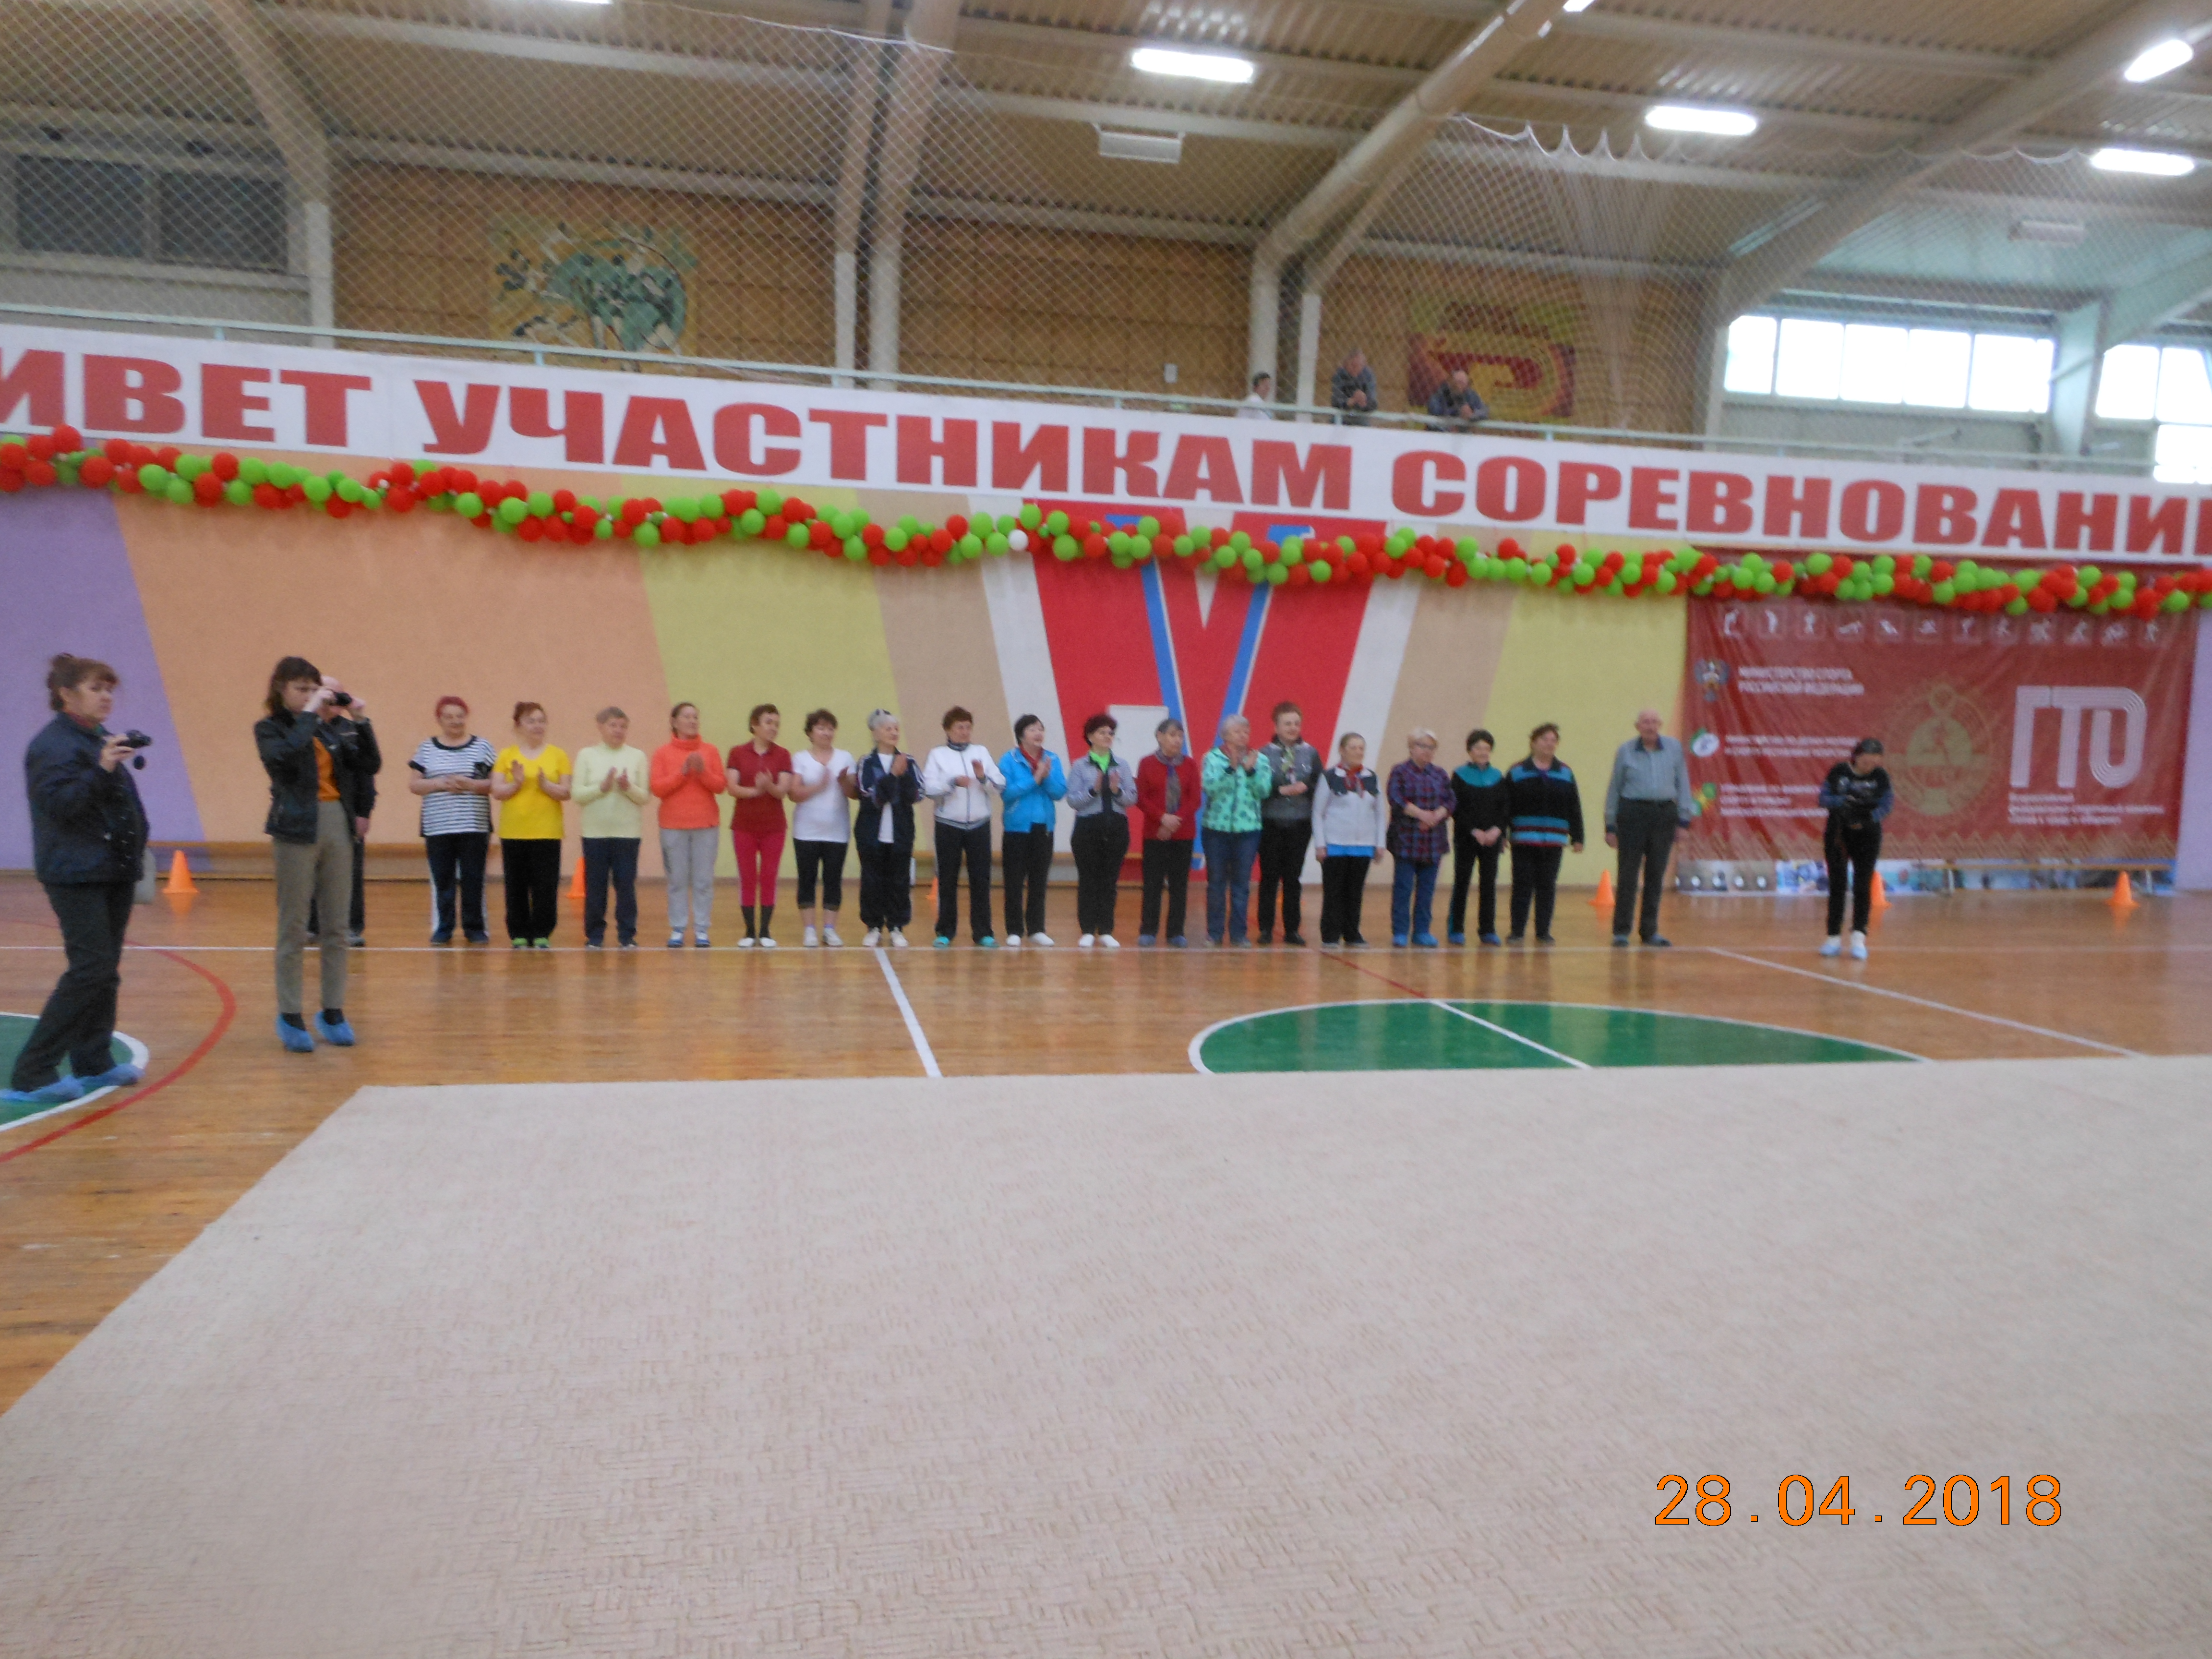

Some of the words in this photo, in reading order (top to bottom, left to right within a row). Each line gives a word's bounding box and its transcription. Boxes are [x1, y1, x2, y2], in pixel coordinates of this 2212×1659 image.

[414, 380, 1352, 510] УЧАСТНИКАМ
[1392, 450, 2212, 555] СОРЕВНОВАНИ
[2009, 685, 2147, 788] ГТО
